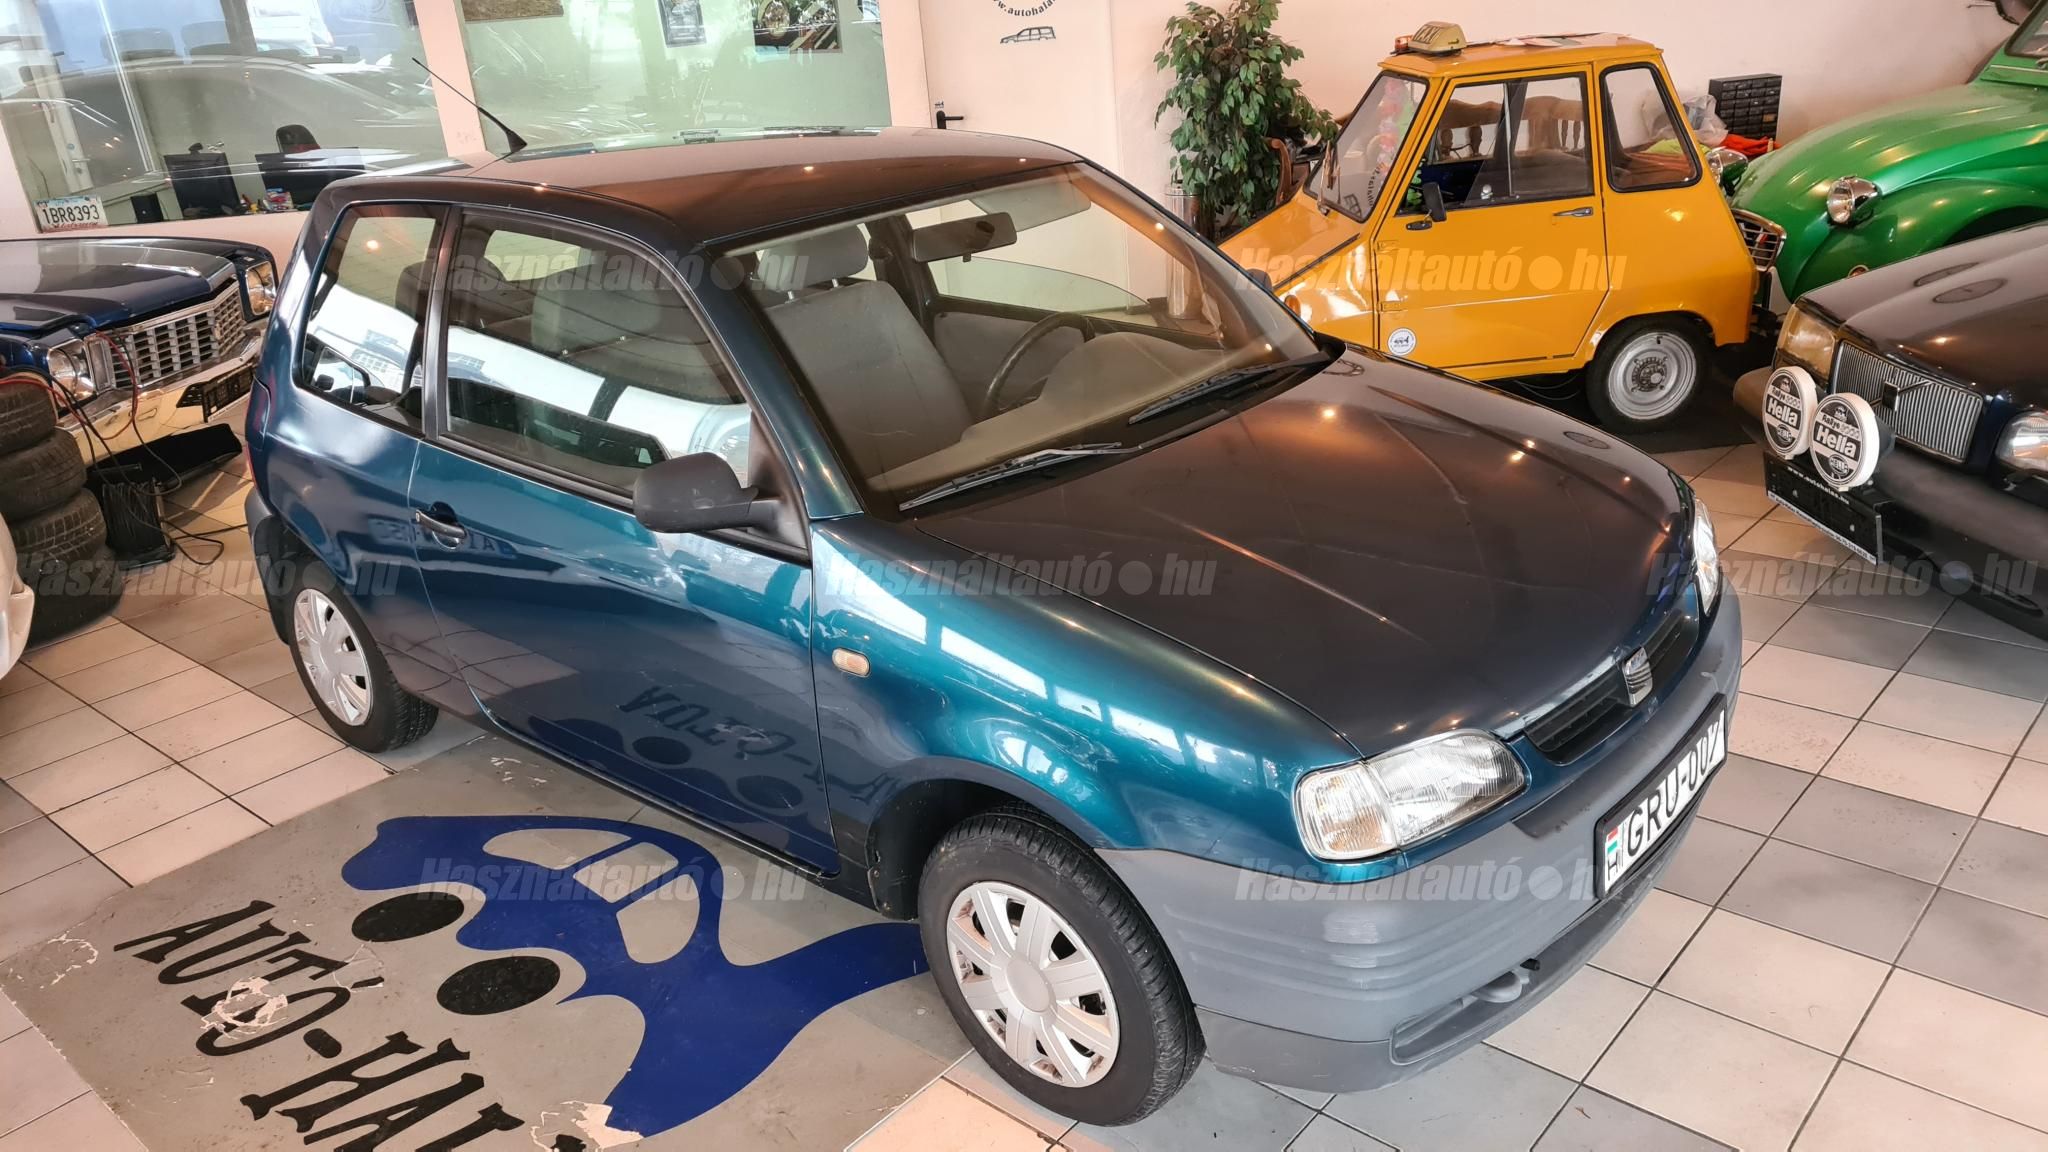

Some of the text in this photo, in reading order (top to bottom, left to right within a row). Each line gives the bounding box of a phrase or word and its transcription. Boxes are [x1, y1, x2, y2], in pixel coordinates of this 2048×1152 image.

[42, 205, 100, 224] 1BR8393
[1767, 397, 1798, 426] Hella
[1816, 424, 1857, 458] Hella
